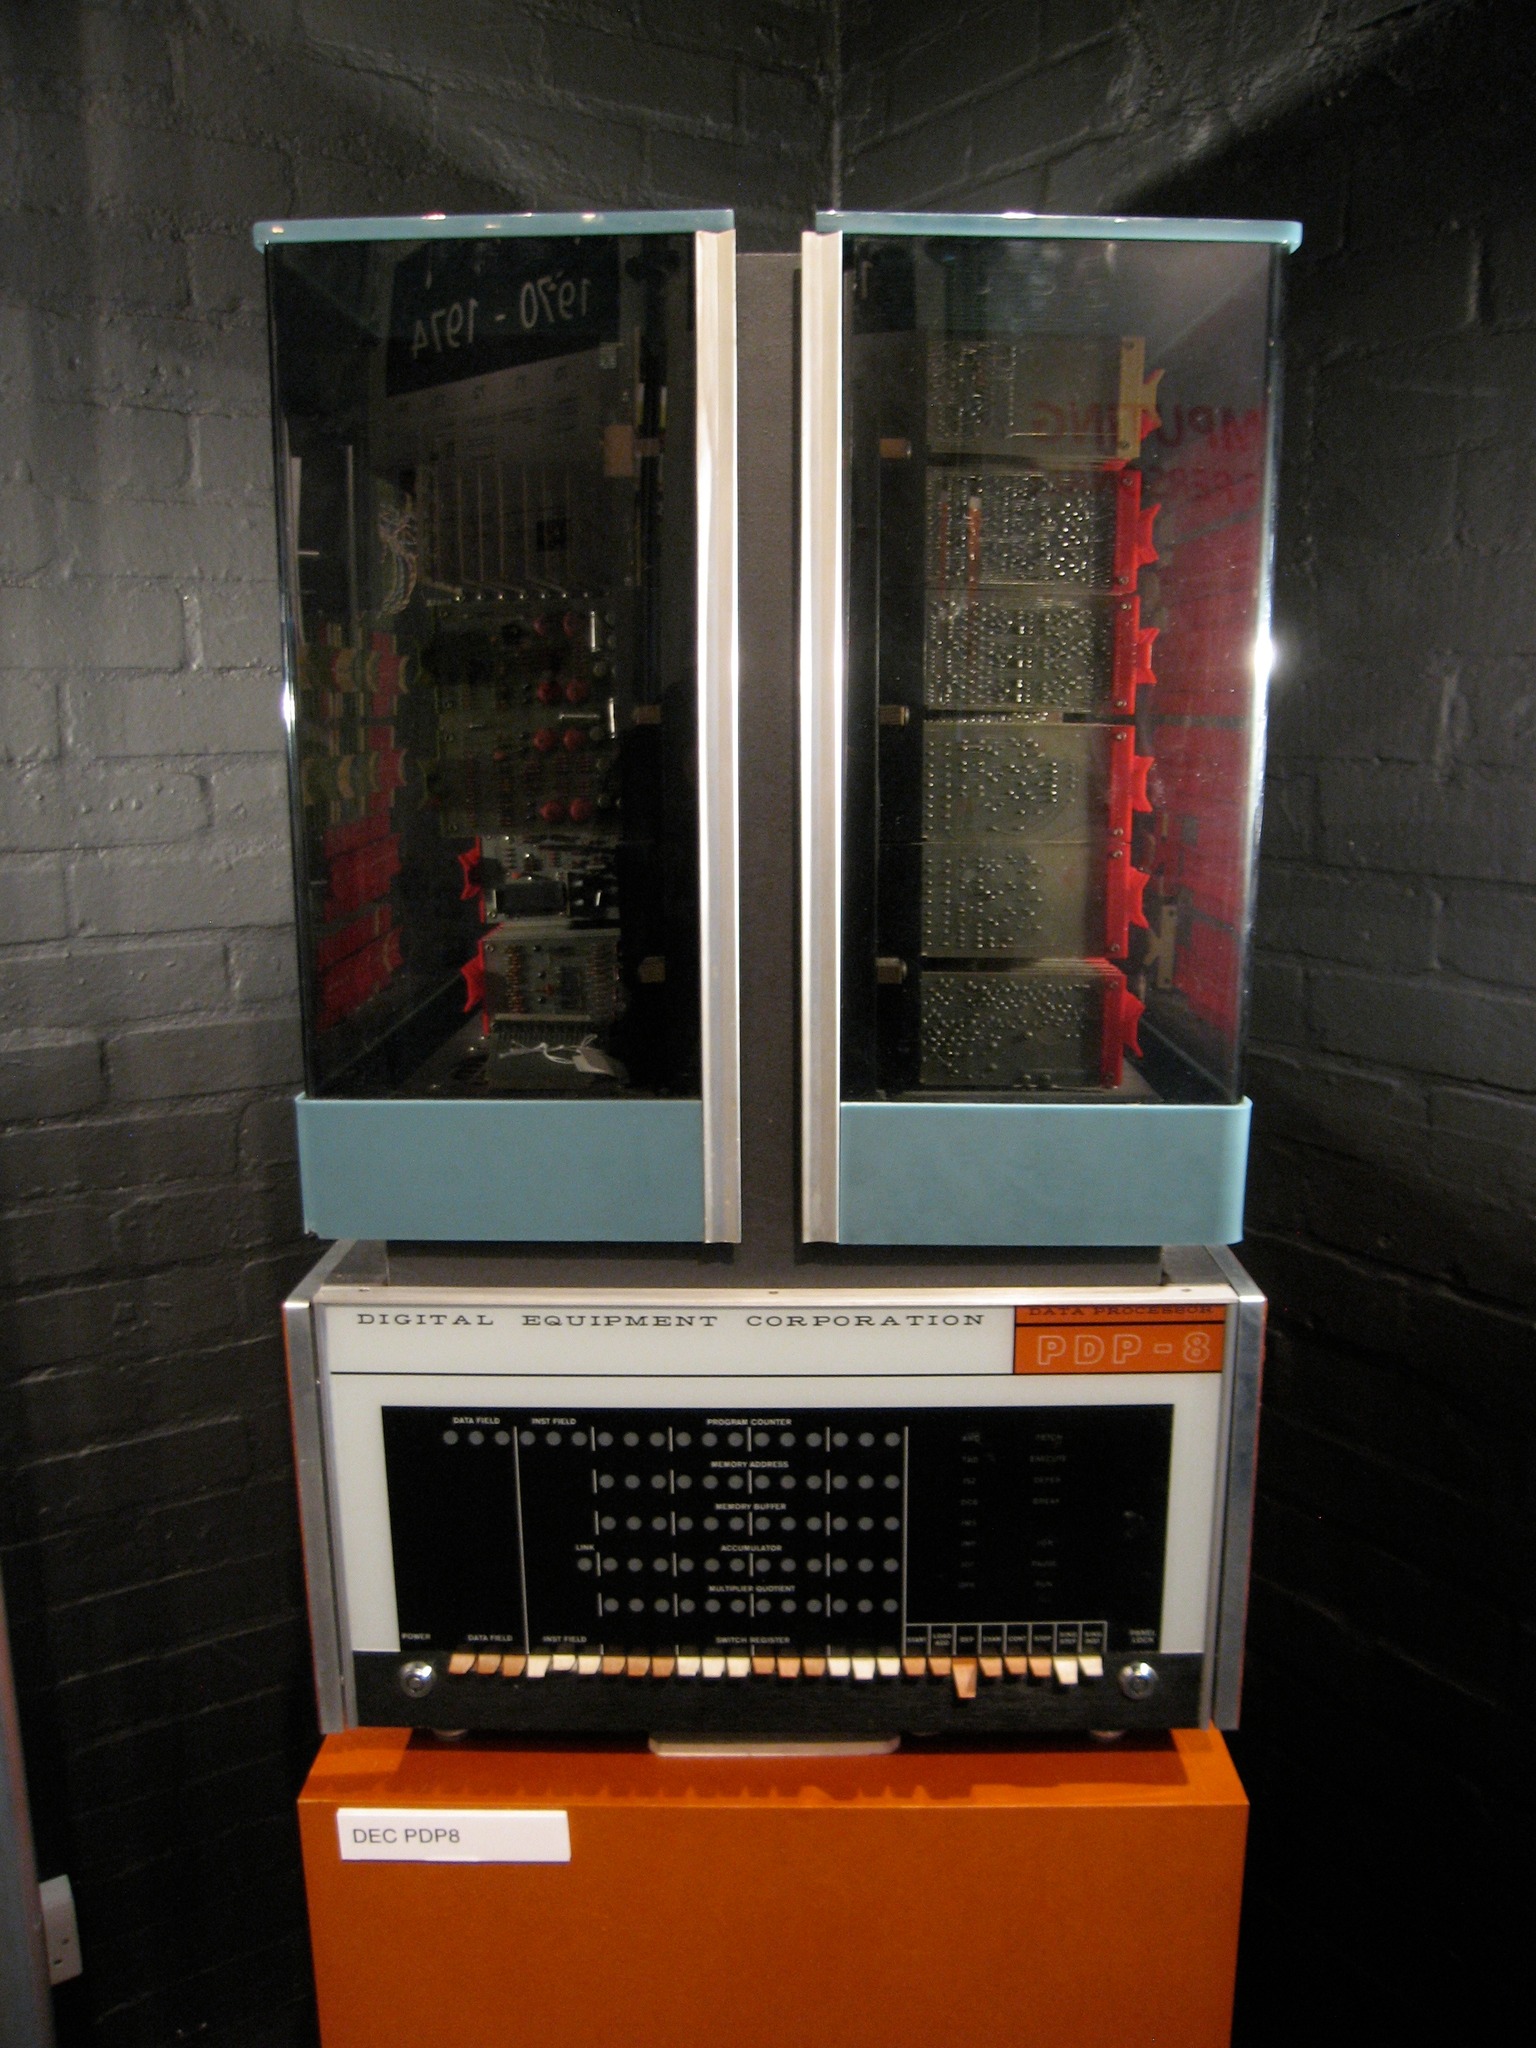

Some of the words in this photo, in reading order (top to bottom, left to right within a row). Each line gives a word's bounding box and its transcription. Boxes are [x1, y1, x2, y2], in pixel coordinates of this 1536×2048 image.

[357, 1313, 495, 1326] DIGITAL
[521, 1314, 718, 1327] EQUIPMENT
[746, 1314, 985, 1327] CORPORATION
[1037, 1332, 1211, 1366] PDP-8
[452, 1416, 475, 1425] DATA
[476, 1416, 501, 1425] FIELD
[552, 1417, 577, 1426] FIELD
[706, 1417, 749, 1426] PROGRAM
[750, 1417, 792, 1426] COUNTER
[710, 1460, 748, 1469] MEMORY
[749, 1460, 789, 1469] ADDRESS
[715, 1502, 752, 1511] MEMORY
[753, 1502, 787, 1511] BUFFER
[574, 1543, 595, 1552] LINK
[720, 1544, 783, 1553] ACCUMULATOR
[708, 1584, 754, 1593] MULTIPLIER
[755, 1584, 796, 1593] QUOTIENT
[401, 1632, 431, 1641] POWER
[466, 1633, 489, 1642] DATA
[489, 1633, 514, 1643] FIELD
[563, 1635, 588, 1644] FIELD
[715, 1635, 748, 1644] SWITCH
[749, 1635, 790, 1644] REGISTER
[353, 1828, 397, 1844] DEC
[404, 1828, 461, 1844] PDP8
